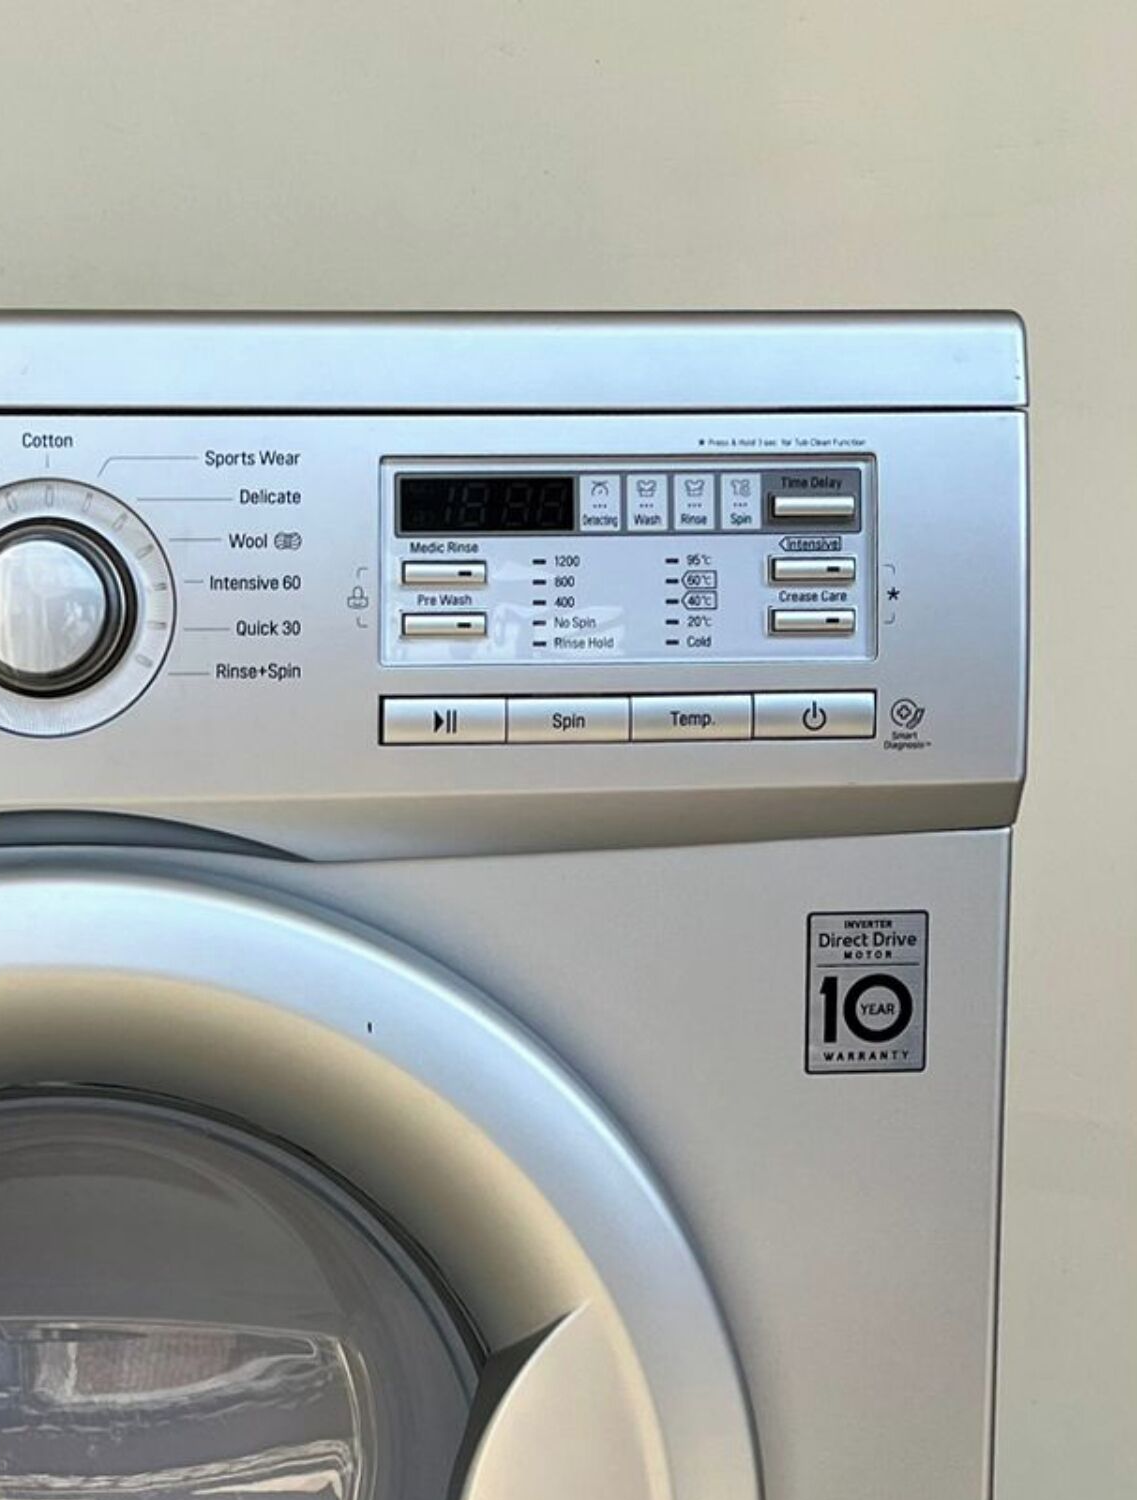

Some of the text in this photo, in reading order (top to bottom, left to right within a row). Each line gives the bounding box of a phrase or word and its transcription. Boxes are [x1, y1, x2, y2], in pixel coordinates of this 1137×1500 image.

[22, 432, 74, 448] Cotton
[205, 449, 301, 468] Sports Wear
[781, 475, 843, 490] Time Delay
[239, 489, 301, 504] Delicate
[634, 514, 662, 526] Wash
[681, 513, 708, 525] Rinse
[730, 513, 752, 526] Spin
[229, 533, 268, 549] Wool
[409, 541, 480, 554] Medic Rinse
[554, 555, 581, 567] 1200
[210, 575, 301, 591] Intensive 60
[417, 594, 473, 606] Pre Wash
[554, 596, 575, 608] 400
[778, 590, 847, 602] Crease Care
[236, 620, 301, 636] Quick 30
[554, 617, 597, 630] No Spin
[554, 637, 615, 649] Rinse Hold
[686, 635, 712, 648] Cold
[216, 662, 301, 682] Rinse+Spin
[552, 712, 586, 731] Spin
[670, 710, 716, 729] Temp.
[844, 919, 893, 929] INVERTER
[818, 931, 917, 948] Direct Drive
[843, 950, 893, 960] MOTOR
[819, 973, 913, 1043] 10
[860, 1002, 896, 1015] YEAR
[823, 1050, 910, 1062] WARRANTY
